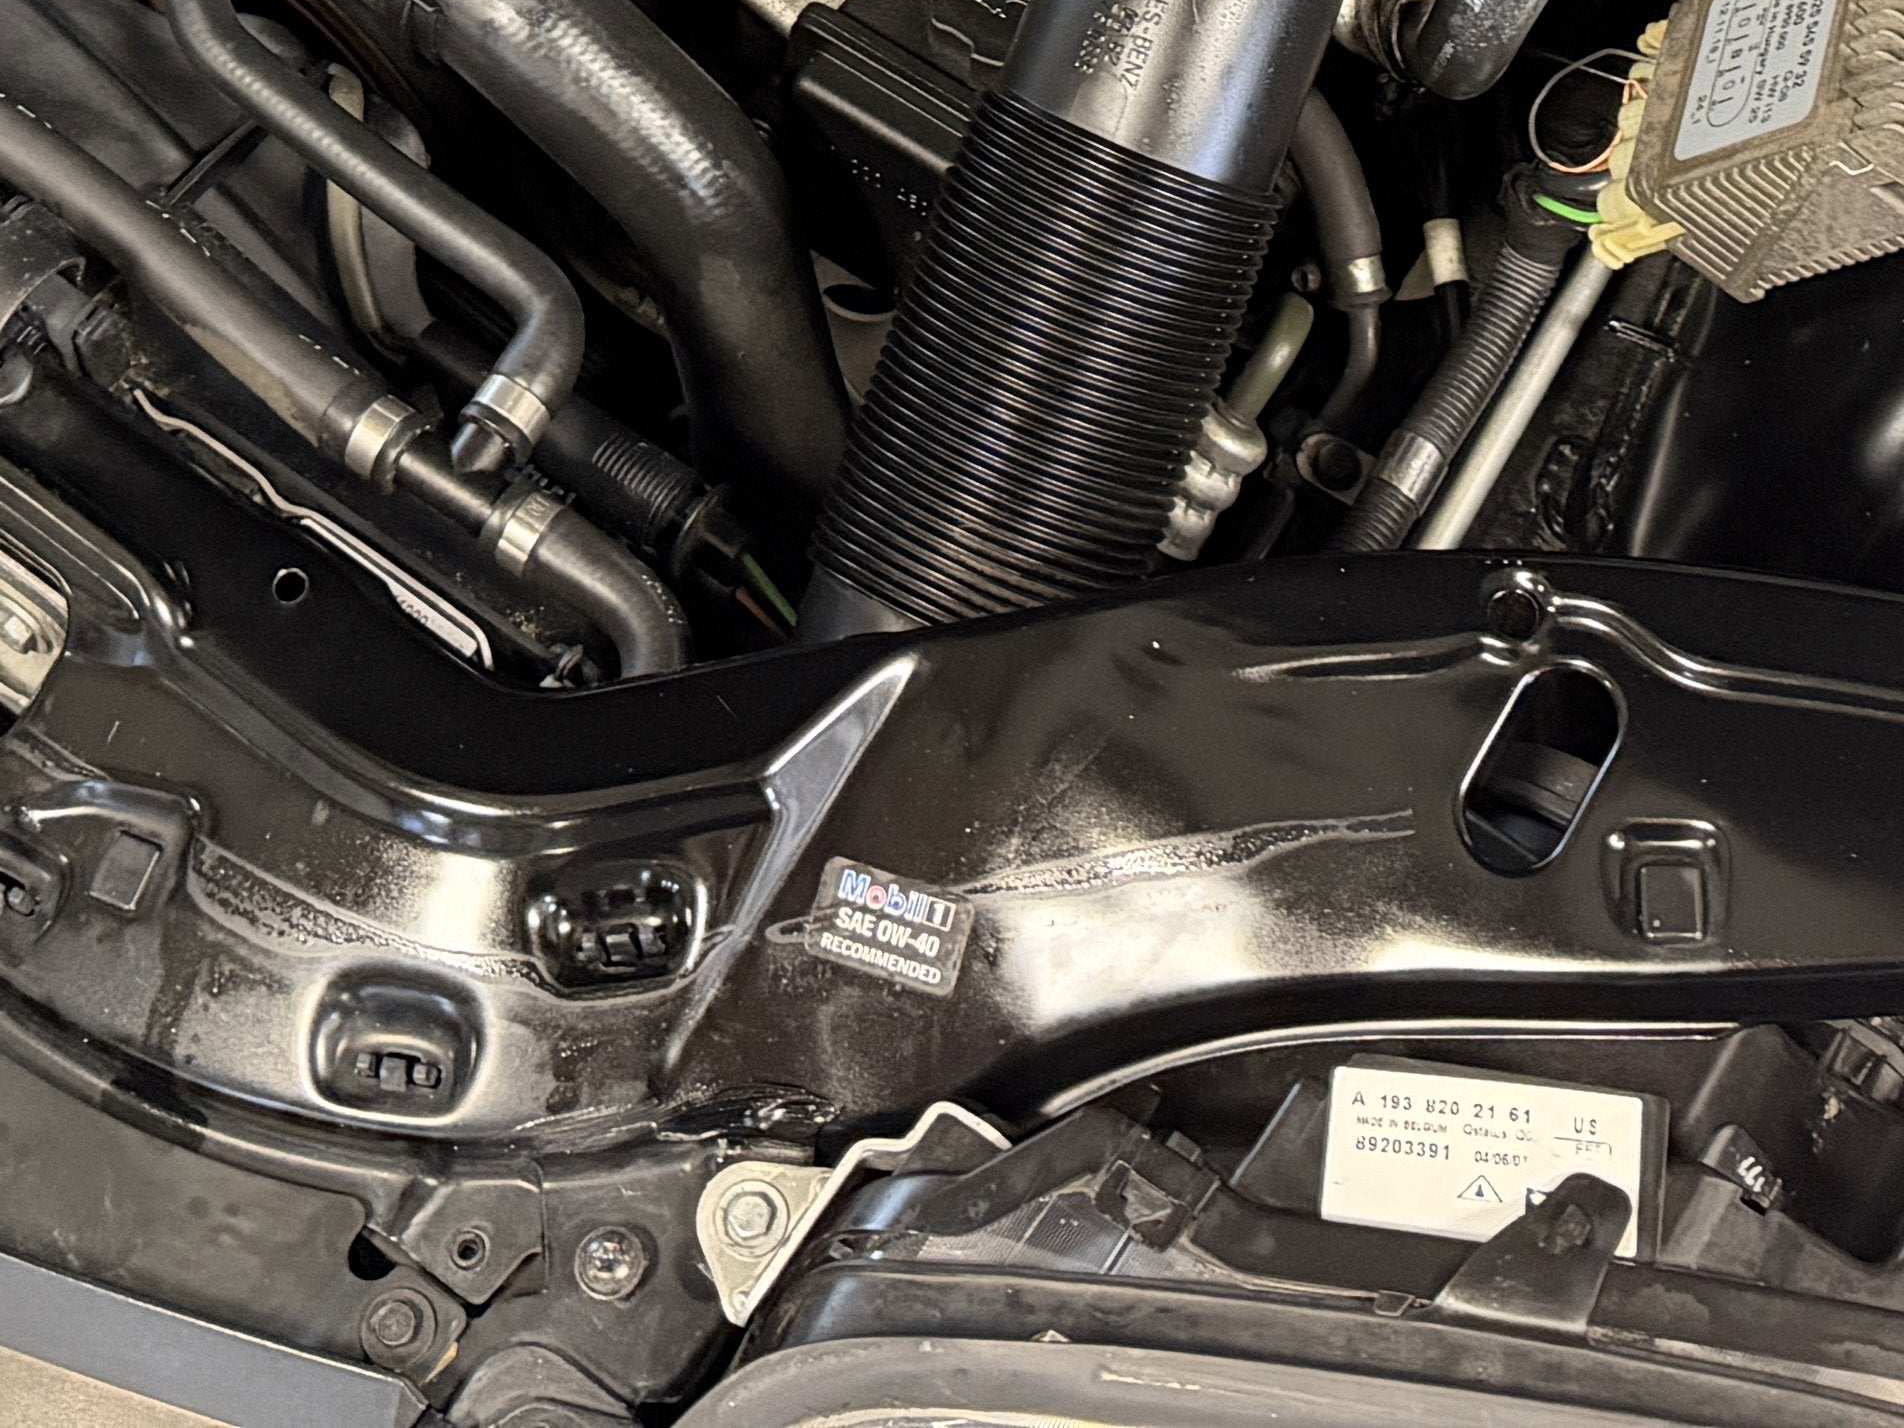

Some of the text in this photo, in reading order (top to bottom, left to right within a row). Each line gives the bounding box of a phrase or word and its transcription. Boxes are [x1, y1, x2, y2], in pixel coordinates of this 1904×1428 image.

[1769, 8, 1780, 22] in
[1791, 0, 1808, 27] 600
[1753, 22, 1778, 76] Hungary
[1800, 18, 1819, 48] 545
[1791, 67, 1808, 90] 32
[836, 868, 929, 923] Mobil
[834, 906, 941, 958] SAE 0W-40
[819, 932, 942, 984] RECOMMENDED
[1351, 1090, 1599, 1136] A 193 820 21 61 US
[1354, 1133, 1452, 1161] 89203391
